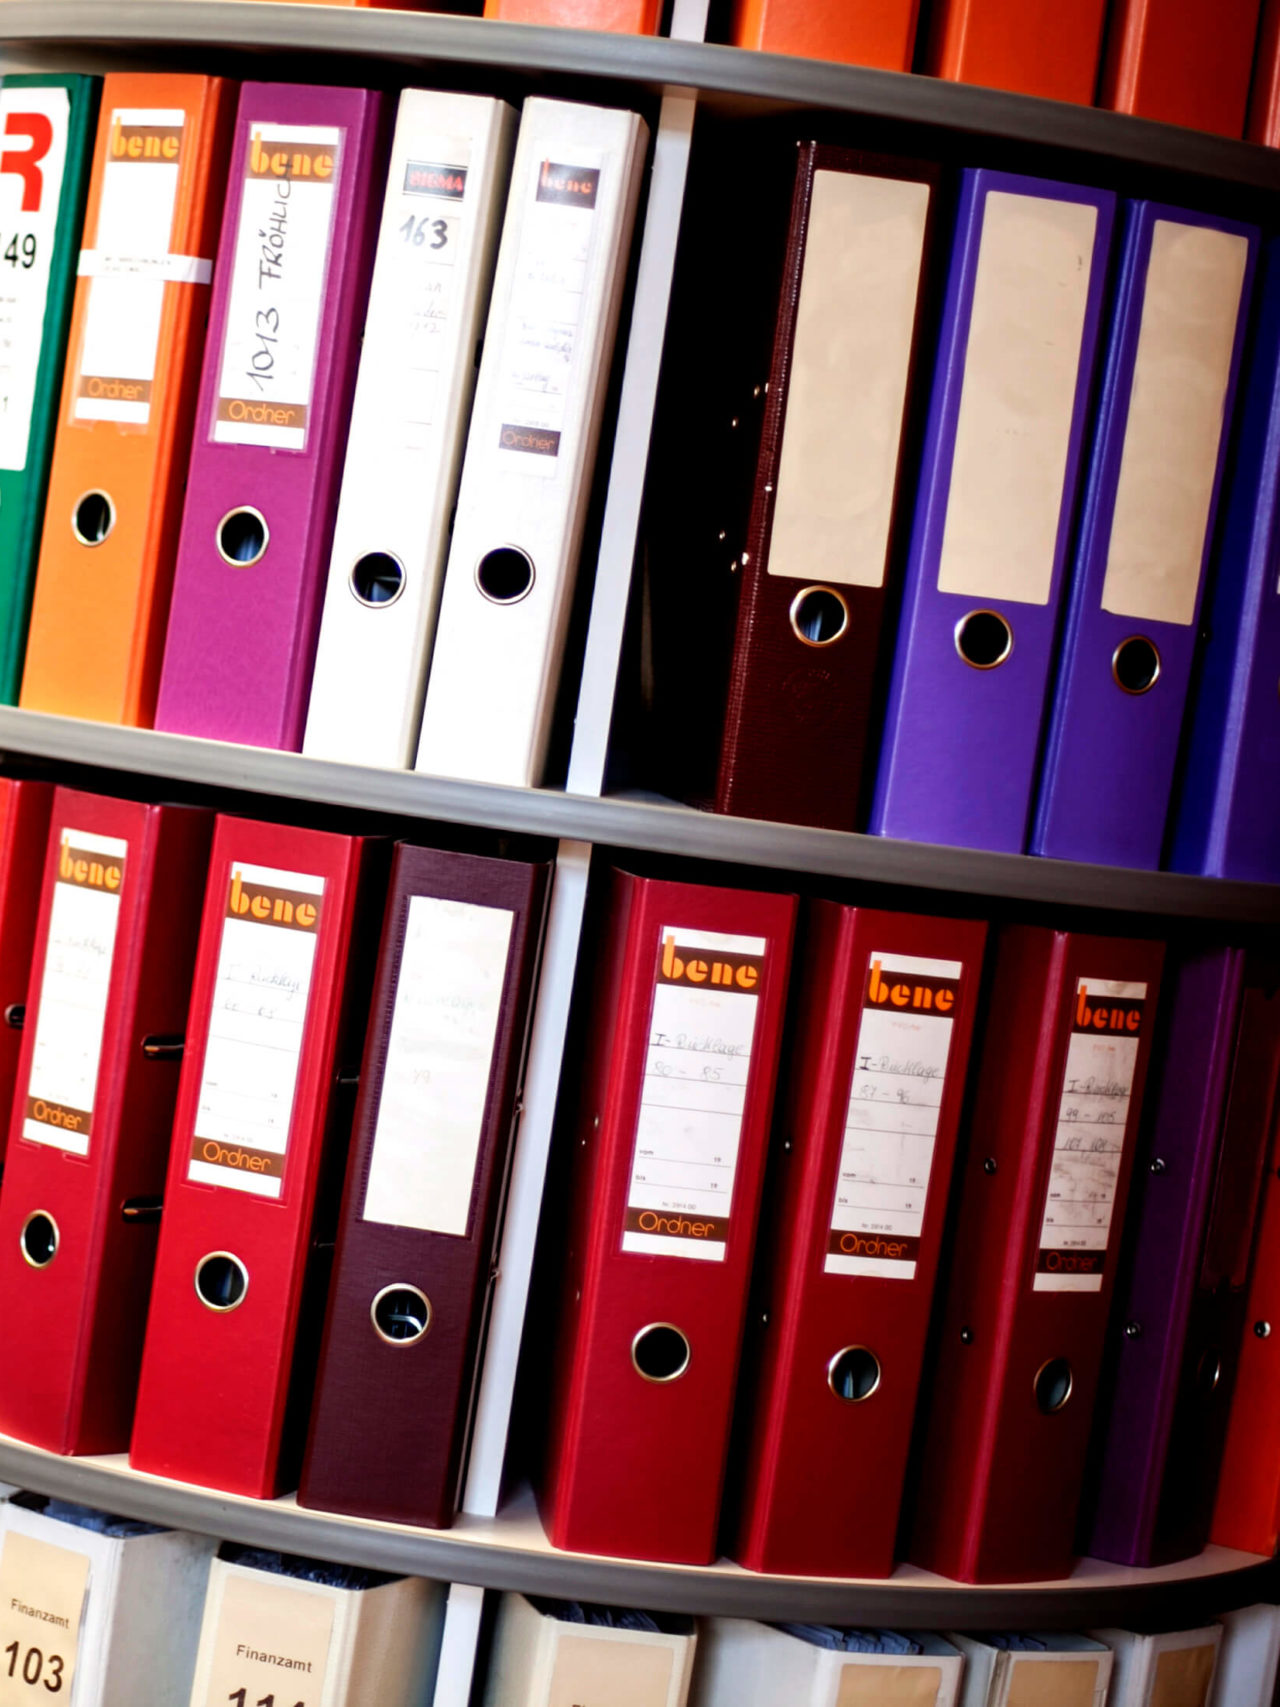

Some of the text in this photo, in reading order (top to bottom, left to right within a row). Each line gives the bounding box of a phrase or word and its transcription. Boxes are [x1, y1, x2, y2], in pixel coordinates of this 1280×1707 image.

[112, 116, 179, 157] bene
[251, 132, 334, 177] bene
[541, 157, 592, 194] bene
[400, 214, 448, 249] 163
[246, 307, 279, 391] 1013
[88, 378, 143, 399] Ordner
[229, 400, 295, 424] Ordner
[503, 430, 555, 450] Ordner
[60, 836, 120, 889] bene
[230, 871, 317, 926] bene
[662, 935, 758, 988] bene
[869, 960, 954, 1011] bene
[1076, 985, 1141, 1031] bene
[33, 1100, 81, 1129] Ordner
[203, 1141, 271, 1171] Ordner
[639, 1211, 715, 1237] Ordner
[840, 1233, 908, 1256] Ordner
[1046, 1252, 1097, 1270] Ordner
[11, 1598, 70, 1629] Finanzamt
[5, 1641, 65, 1693] 103
[236, 1643, 313, 1674] Finanzamt
